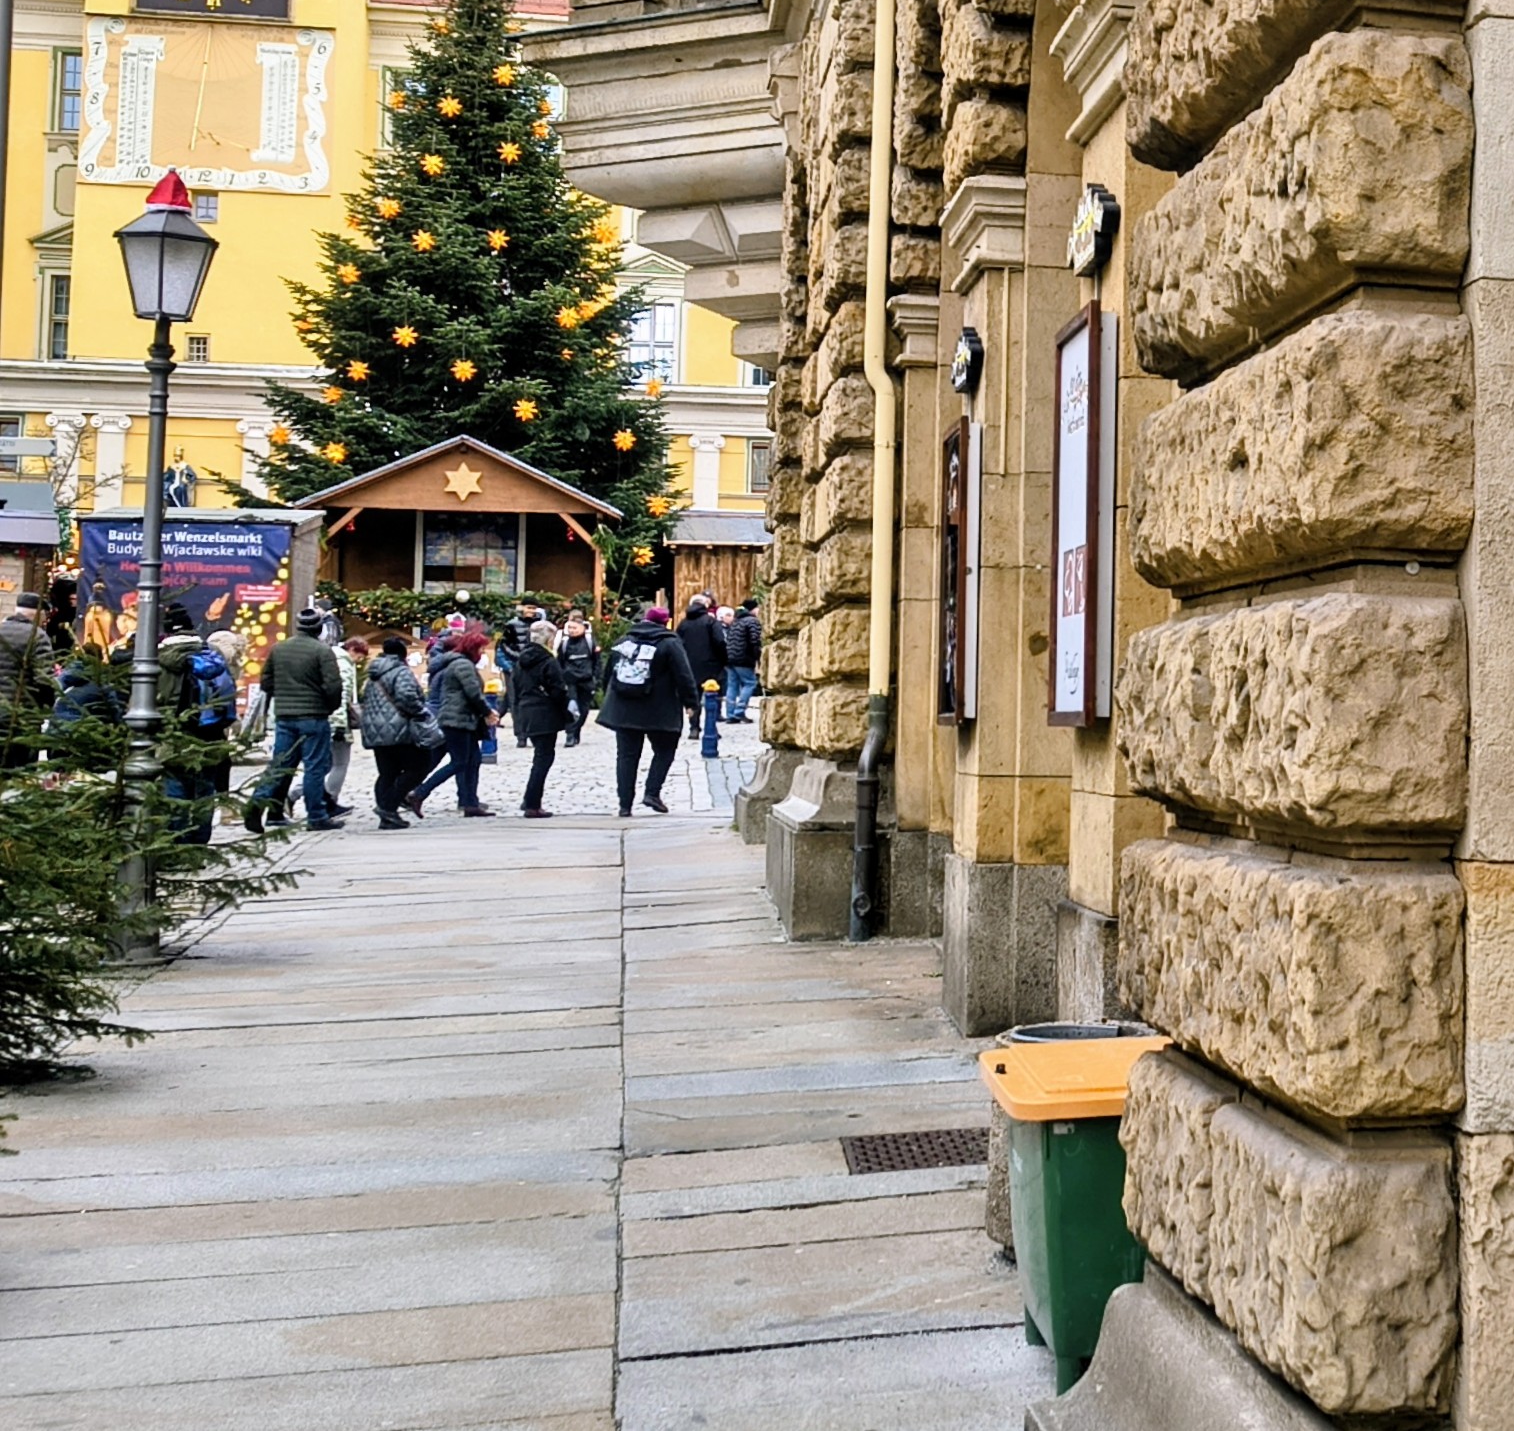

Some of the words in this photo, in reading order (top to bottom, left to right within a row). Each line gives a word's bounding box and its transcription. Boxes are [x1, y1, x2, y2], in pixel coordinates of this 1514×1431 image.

[92, 41, 102, 56] 7
[317, 41, 327, 55] 6
[90, 91, 99, 105] 8
[84, 163, 95, 176] 9
[135, 166, 150, 179] 10
[257, 171, 267, 185] 2
[298, 176, 309, 190] 3
[108, 530, 172, 543] Bautzer
[174, 530, 263, 544] Wenzelsmarkt
[237, 545, 263, 557] wiki
